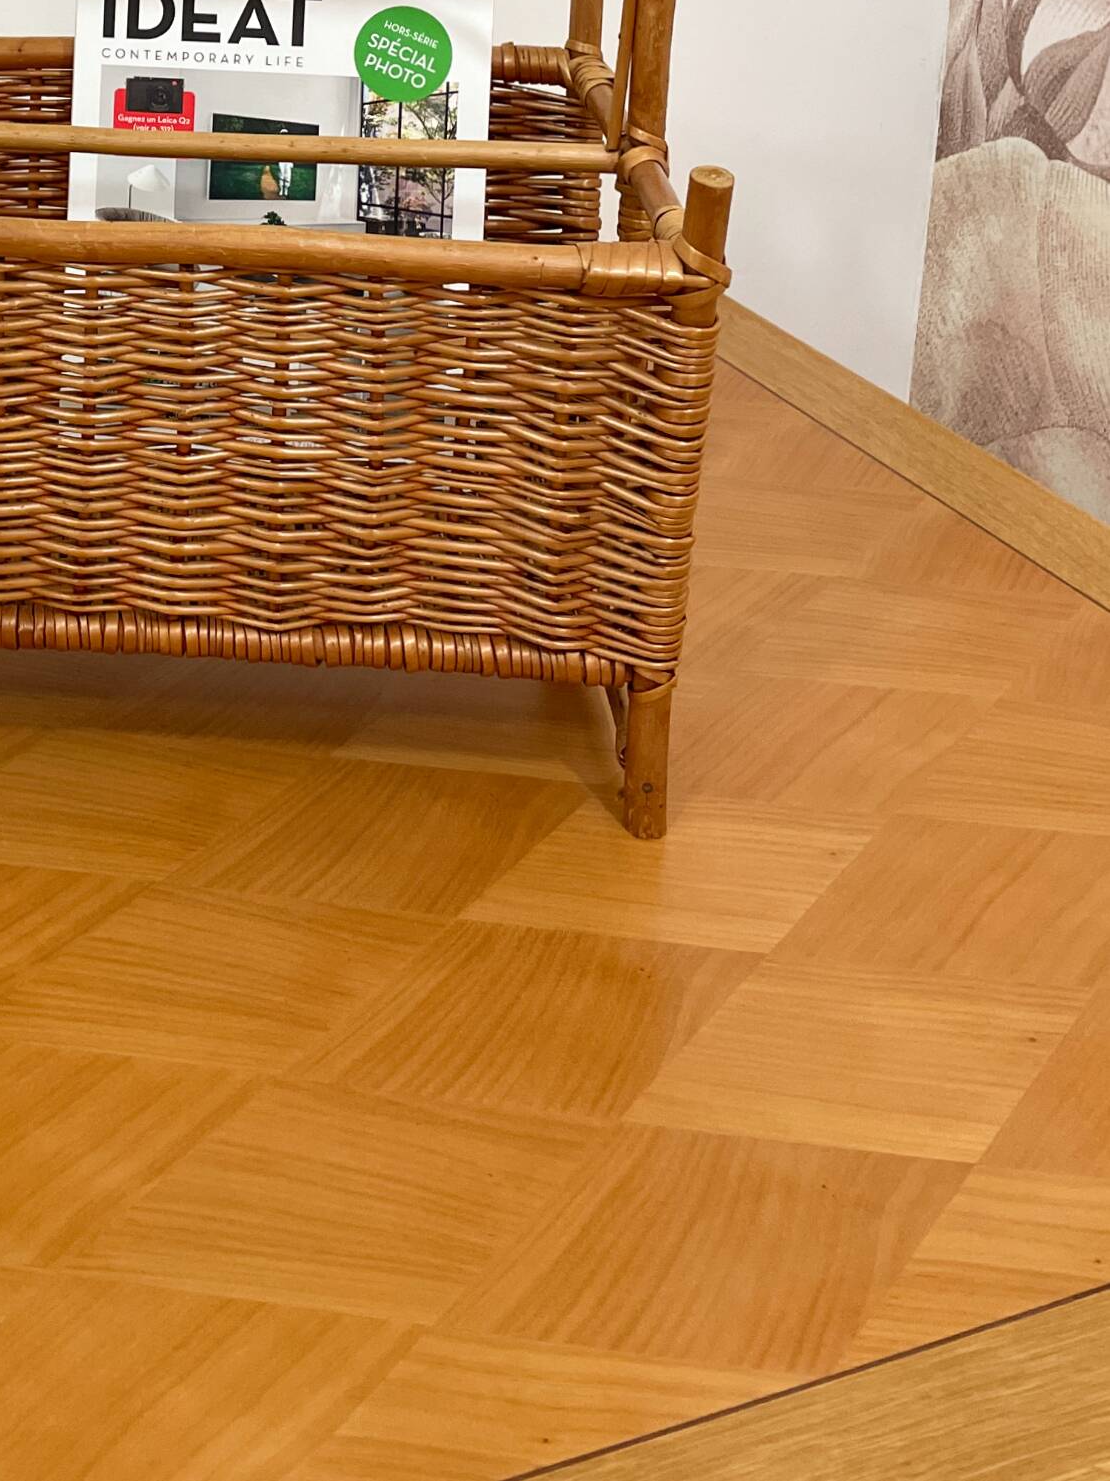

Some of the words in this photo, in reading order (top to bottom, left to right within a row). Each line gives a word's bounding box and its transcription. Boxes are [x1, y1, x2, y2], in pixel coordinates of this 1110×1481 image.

[383, 20, 439, 49] HORS-SÉRIE
[101, 47, 255, 65] CONTEMPORARY
[265, 56, 305, 68] LIFE
[367, 33, 436, 73] SPÉCIAL
[364, 53, 426, 89] PHOTO
[117, 113, 145, 124] Gagnez
[157, 116, 178, 124] Leica
